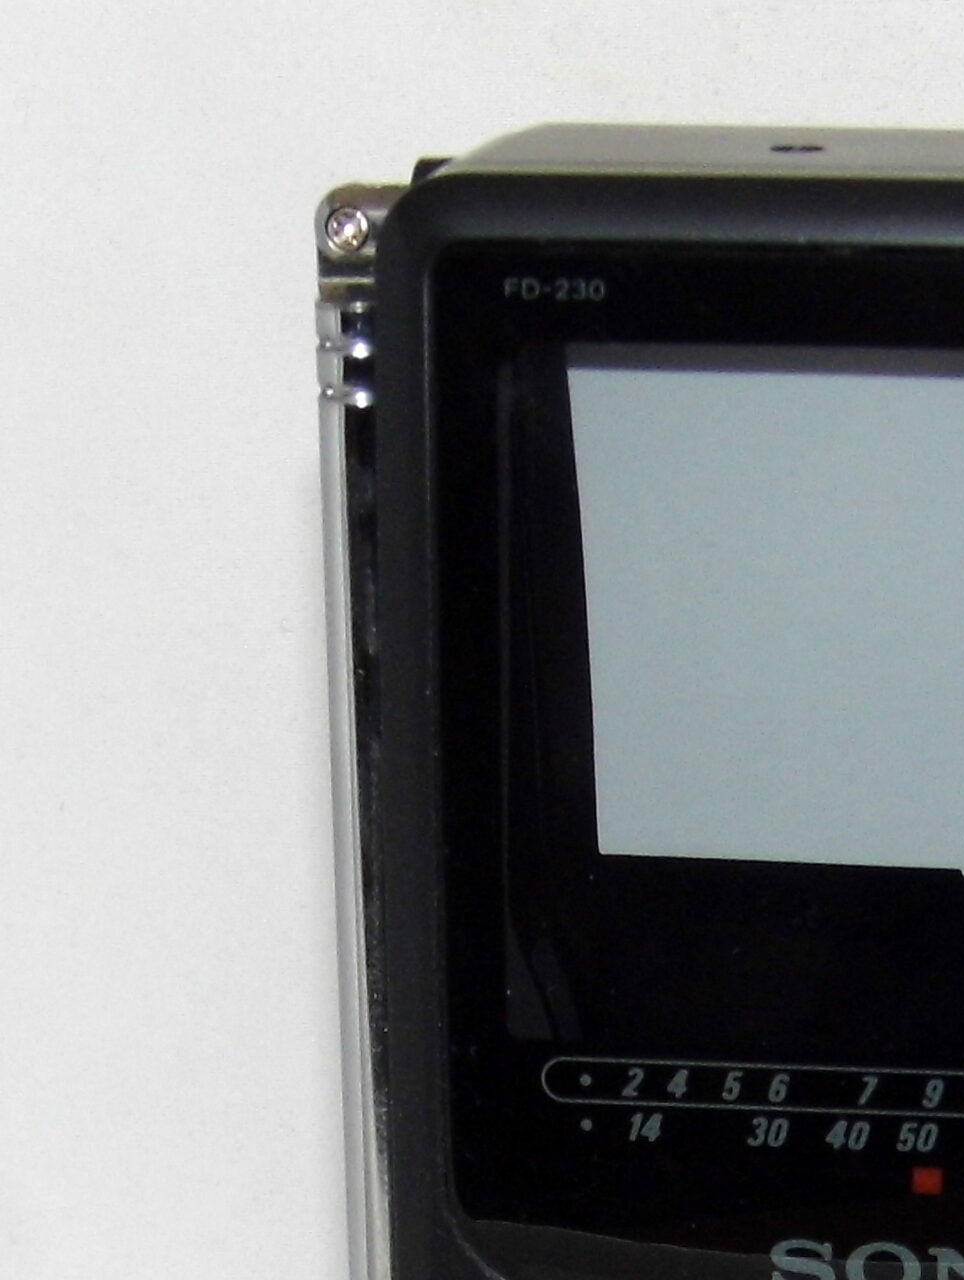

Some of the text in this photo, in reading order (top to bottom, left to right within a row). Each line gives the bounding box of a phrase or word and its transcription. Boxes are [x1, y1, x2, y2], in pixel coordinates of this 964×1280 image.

[504, 278, 606, 299] FD-230
[621, 1068, 645, 1097] 2
[666, 1069, 689, 1098] 4
[721, 1072, 743, 1101] 5
[769, 1074, 791, 1104] 6
[858, 1077, 879, 1106] 7
[922, 1079, 944, 1108] 9
[628, 1113, 663, 1143] 14
[746, 1117, 788, 1148] 30
[825, 1120, 870, 1151] 40
[896, 1123, 939, 1153] 50
